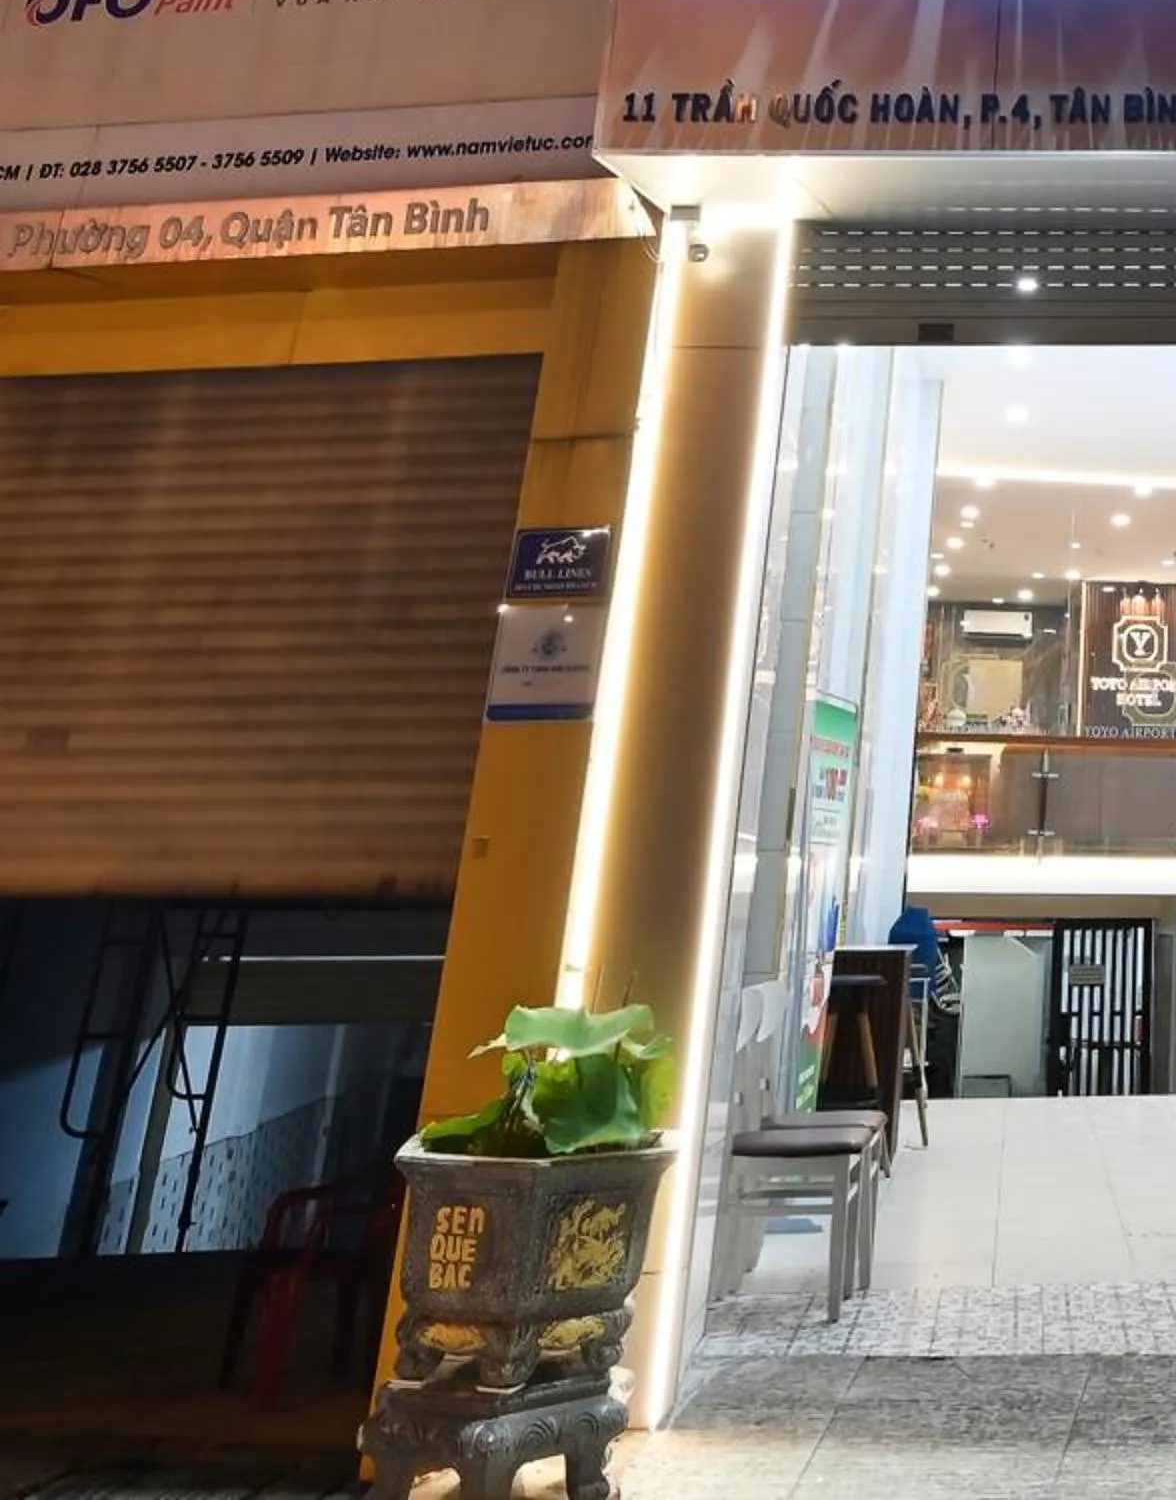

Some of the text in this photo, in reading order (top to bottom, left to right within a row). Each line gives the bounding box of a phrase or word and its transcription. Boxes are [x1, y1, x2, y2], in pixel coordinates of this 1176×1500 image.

[622, 92, 656, 123] 11
[671, 78, 757, 125] TRẦN
[768, 79, 858, 129] QUỐC
[1049, 86, 1111, 124] TÂN
[69, 159, 102, 178] 028
[106, 160, 149, 176] 3756
[153, 155, 198, 172] 5507
[211, 152, 255, 170] 3756
[259, 149, 305, 166] 5509
[324, 145, 401, 163] Website:
[7, 198, 490, 260] Phường 04, Quận Tân Bình
